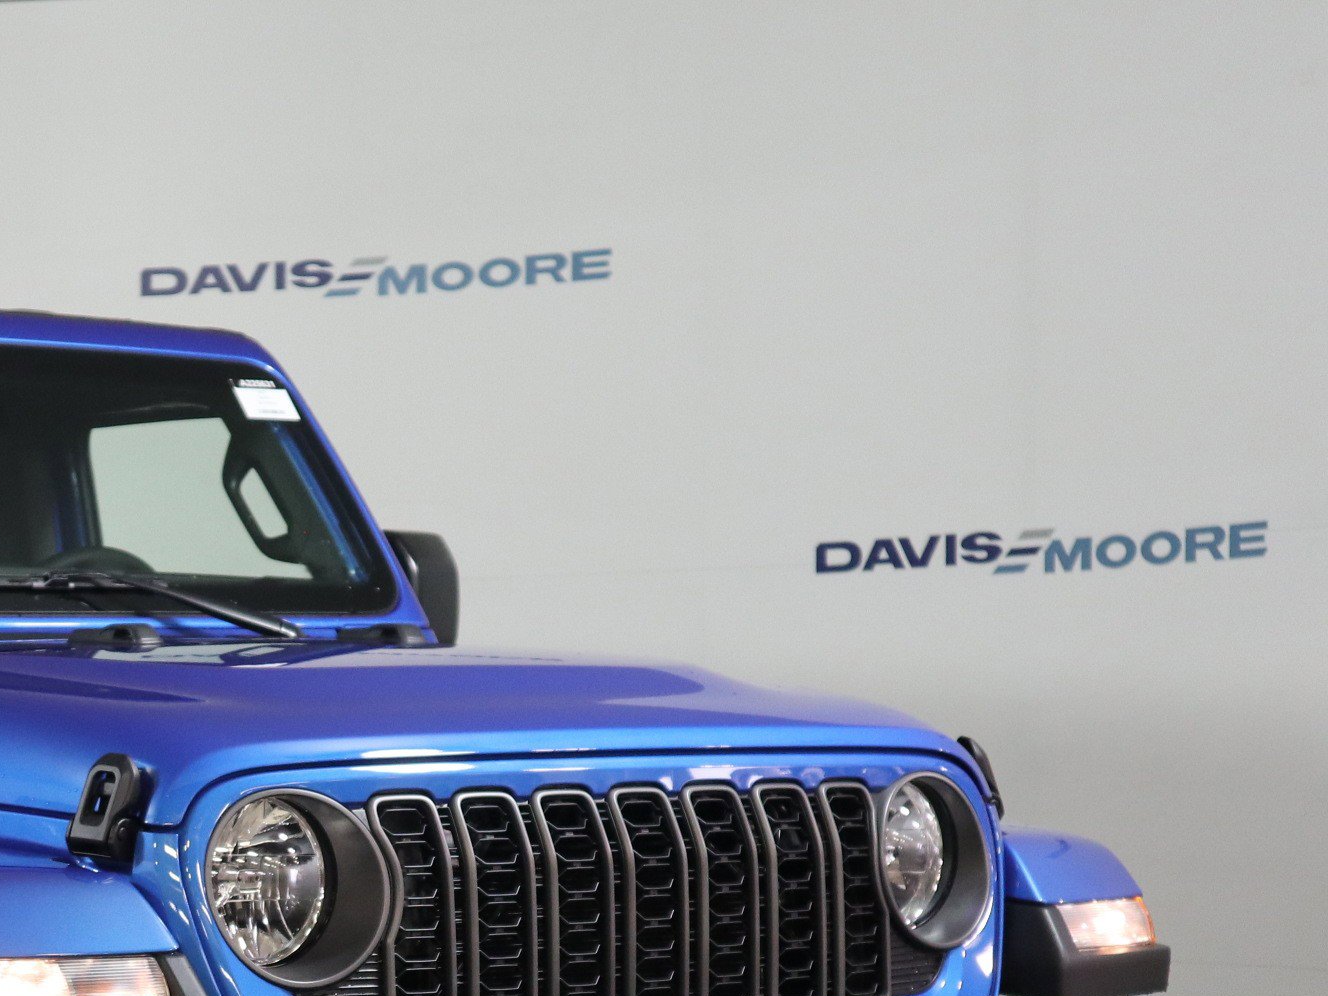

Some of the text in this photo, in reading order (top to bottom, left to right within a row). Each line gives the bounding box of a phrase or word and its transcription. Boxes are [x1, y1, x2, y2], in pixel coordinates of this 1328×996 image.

[139, 247, 613, 298] DAVIS MOORE
[814, 519, 1269, 576] DAVIS MOORE
